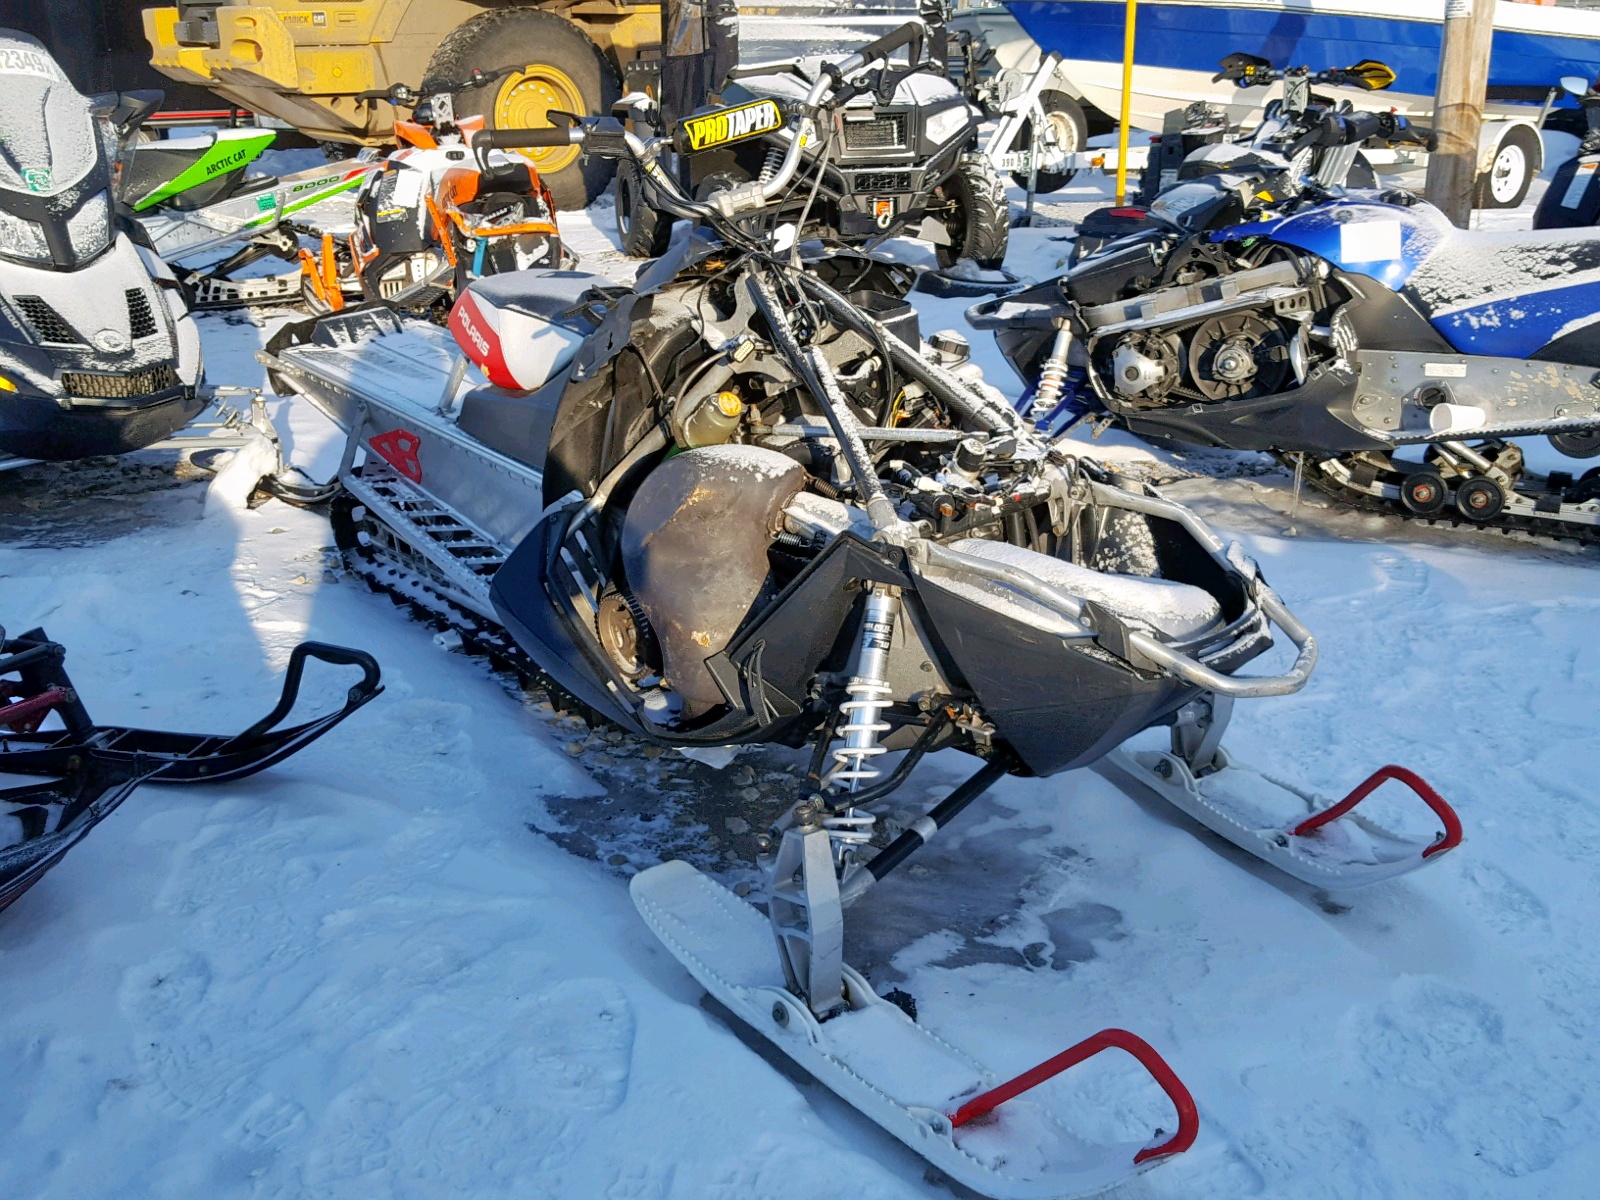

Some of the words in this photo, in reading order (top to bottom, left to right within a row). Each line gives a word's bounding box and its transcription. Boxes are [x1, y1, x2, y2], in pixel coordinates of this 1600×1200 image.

[313, 14, 325, 24] CAT
[692, 102, 776, 149] PROTAPER
[206, 155, 233, 176] ARCTIC
[233, 148, 246, 163] CAT
[457, 304, 490, 357] POLARIS
